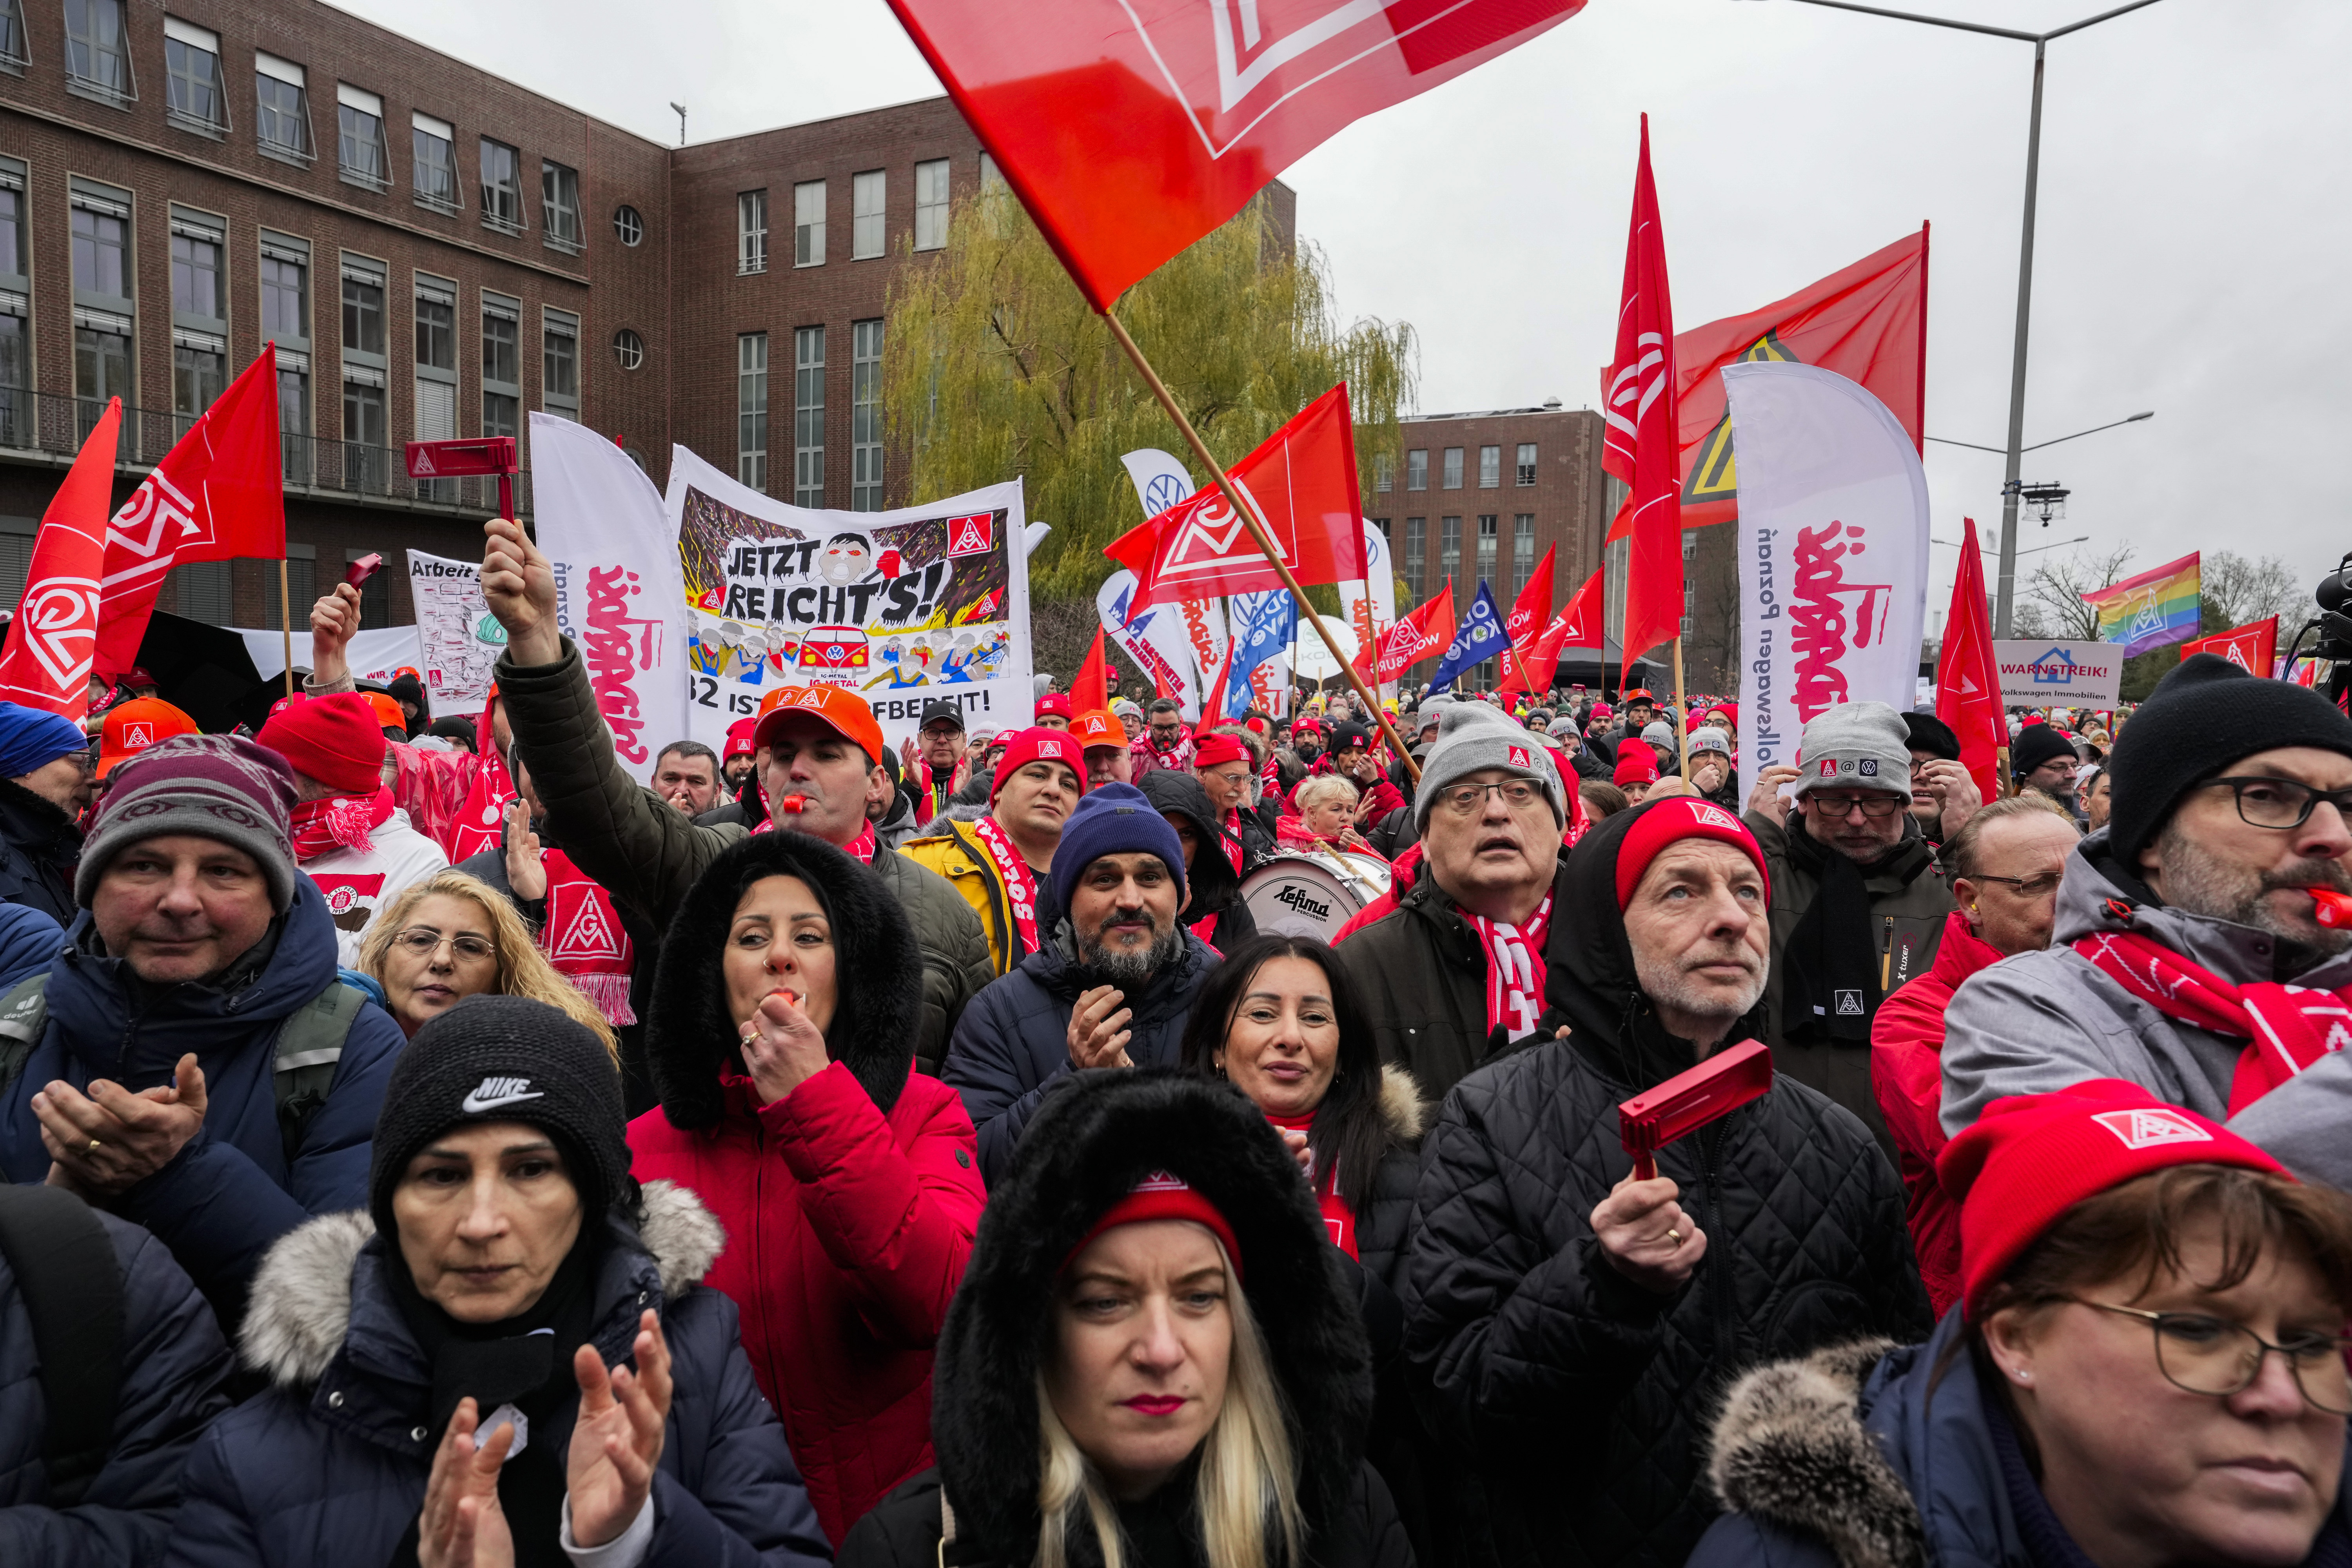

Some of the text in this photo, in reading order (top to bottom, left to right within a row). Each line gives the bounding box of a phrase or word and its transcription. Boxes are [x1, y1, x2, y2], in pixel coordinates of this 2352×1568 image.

[952, 520, 986, 554] IGM
[411, 561, 473, 578] Arbeit
[728, 540, 821, 586] JETZT
[367, 671, 388, 680] WIR,
[2001, 664, 2107, 677] WARNSTREIK!
[2000, 689, 2106, 700] Volkswagen Immobilien
[127, 727, 149, 745] IGM
[344, 887, 356, 898] PAULI
[1297, 909, 1327, 922] PERCUSSION
[3, 1009, 37, 1019] deuter
[475, 1077, 531, 1098] NIKE
